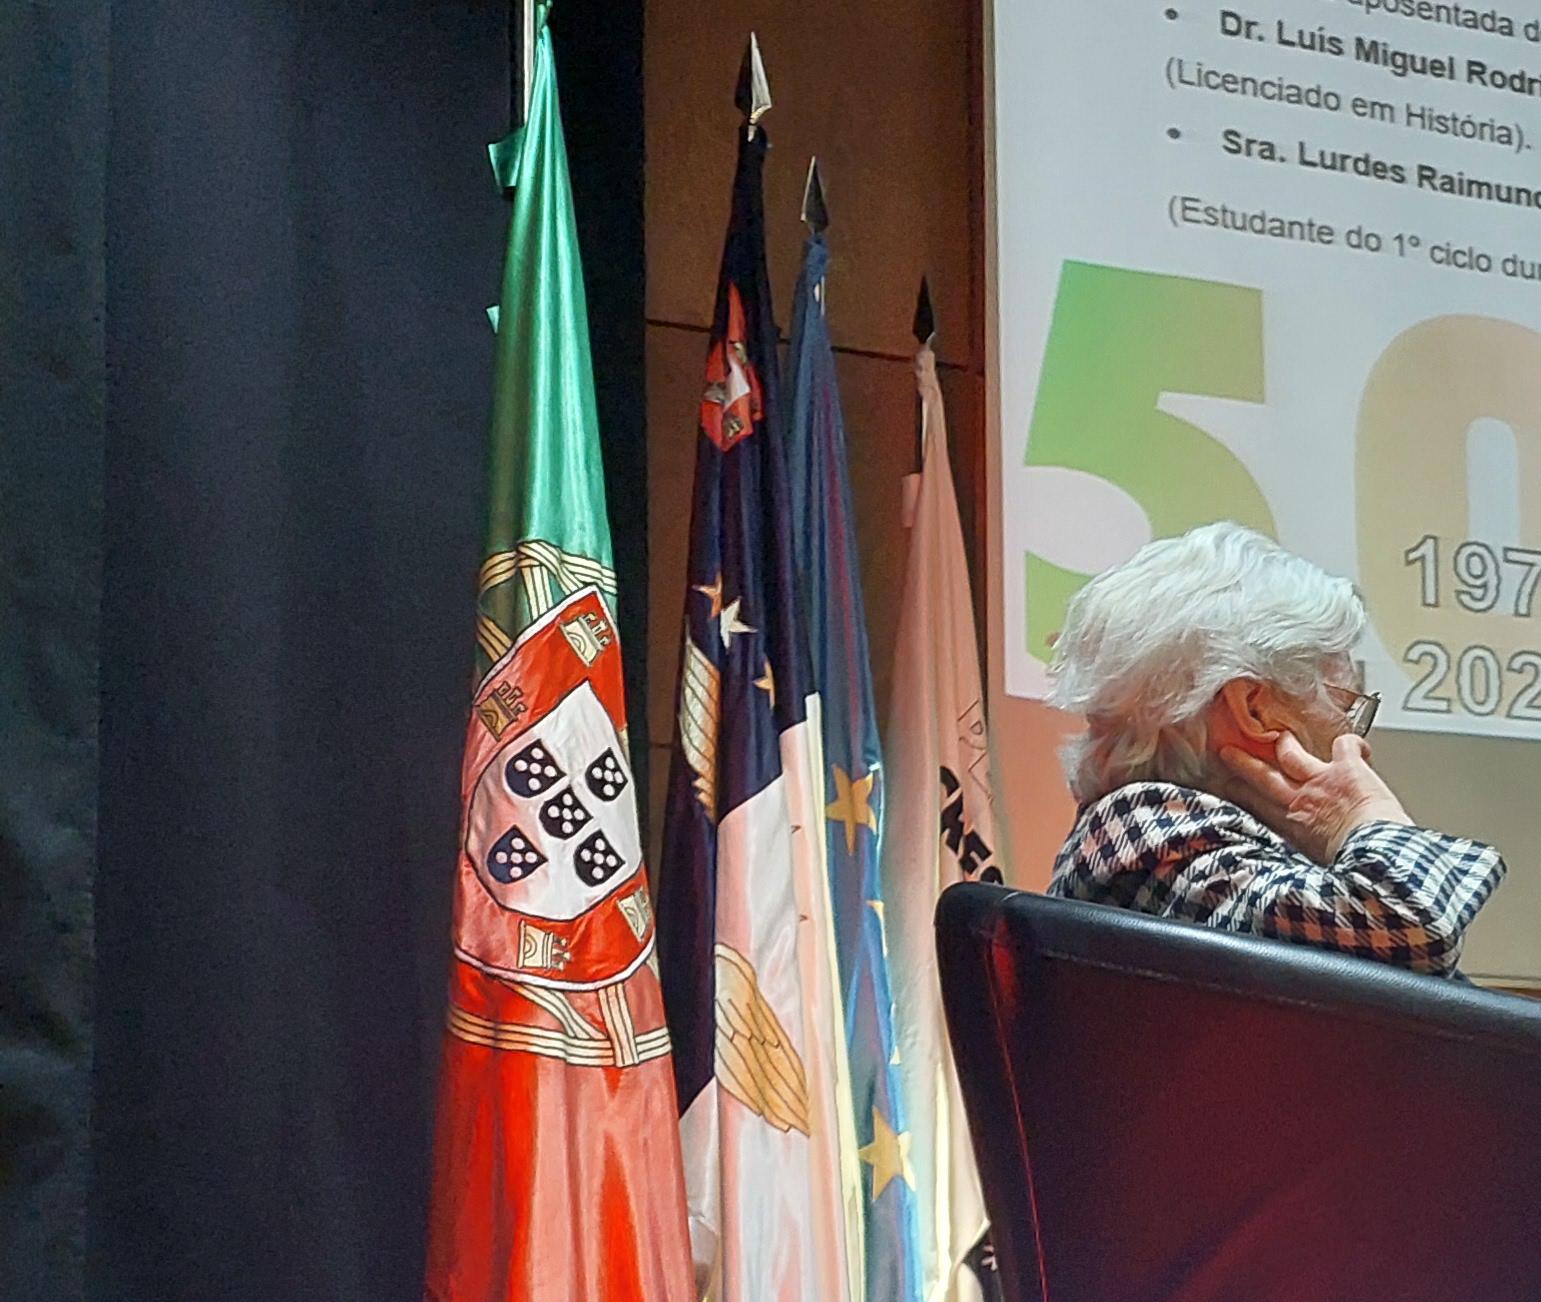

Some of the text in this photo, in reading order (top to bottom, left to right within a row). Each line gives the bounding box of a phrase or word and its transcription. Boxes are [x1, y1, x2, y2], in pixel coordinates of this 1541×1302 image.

[1220, 10, 1265, 42] Dr.
[1277, 20, 1345, 56] Luís
[1355, 36, 1456, 80] Miguel
[1166, 57, 1532, 154] (Licenciado em História).
[1222, 129, 1287, 163] Sra.
[1299, 141, 1408, 184] Lurdes
[1169, 196, 1335, 245] (Estudante
[1345, 225, 1382, 252] do
[1393, 233, 1421, 257] 1º
[1430, 242, 1492, 272] ciclo
